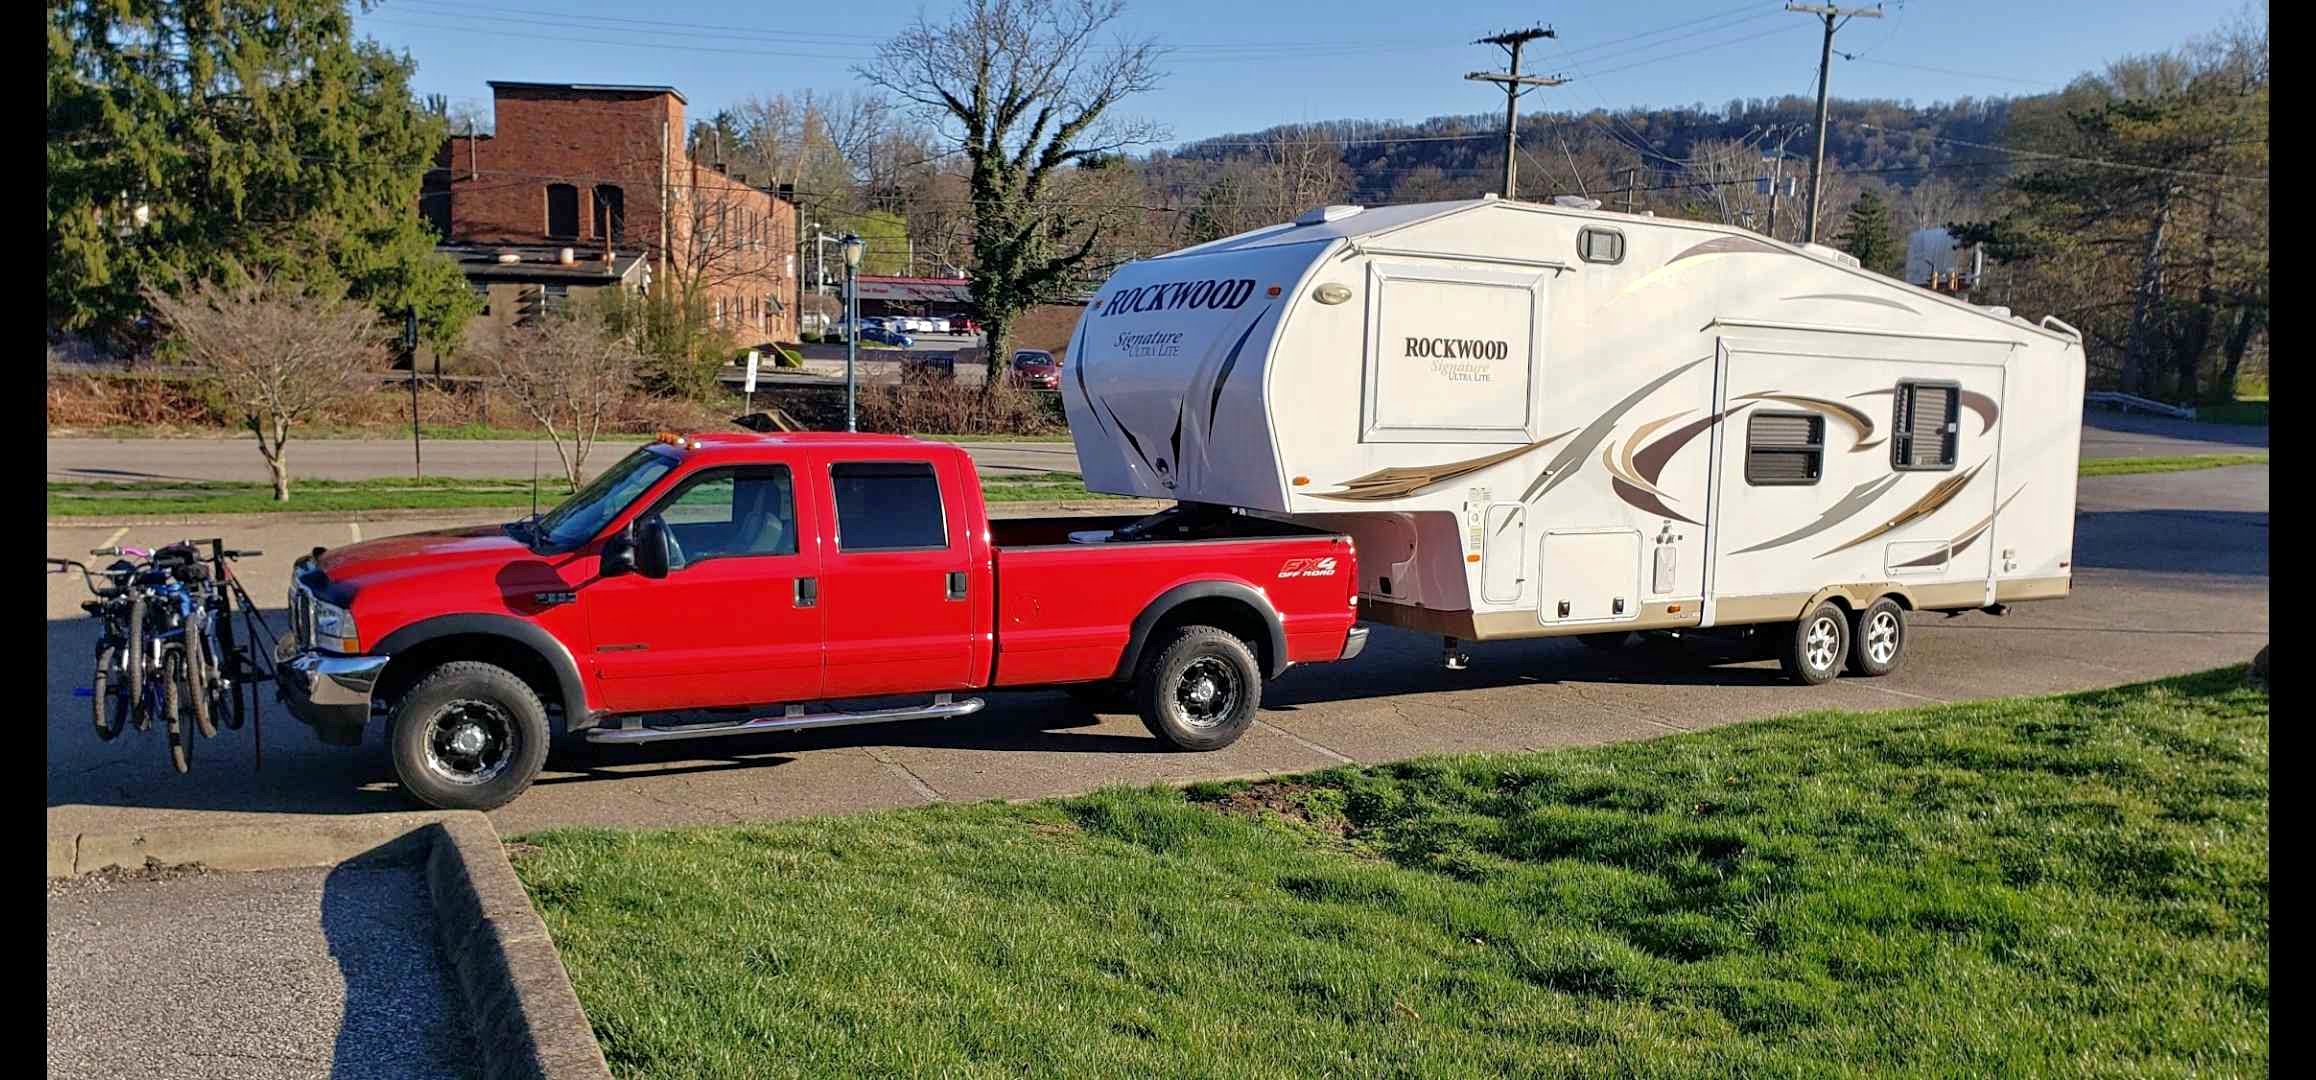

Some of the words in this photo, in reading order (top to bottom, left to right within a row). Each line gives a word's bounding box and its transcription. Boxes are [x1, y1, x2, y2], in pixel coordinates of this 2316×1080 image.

[1101, 279, 1256, 317] ROCKWOOD
[1113, 331, 1183, 351] Signature
[1404, 337, 1508, 360] ROCKWOOD
[1158, 344, 1180, 357] LITE
[1281, 557, 1338, 572] FX4
[1302, 569, 1336, 577] ROAD
